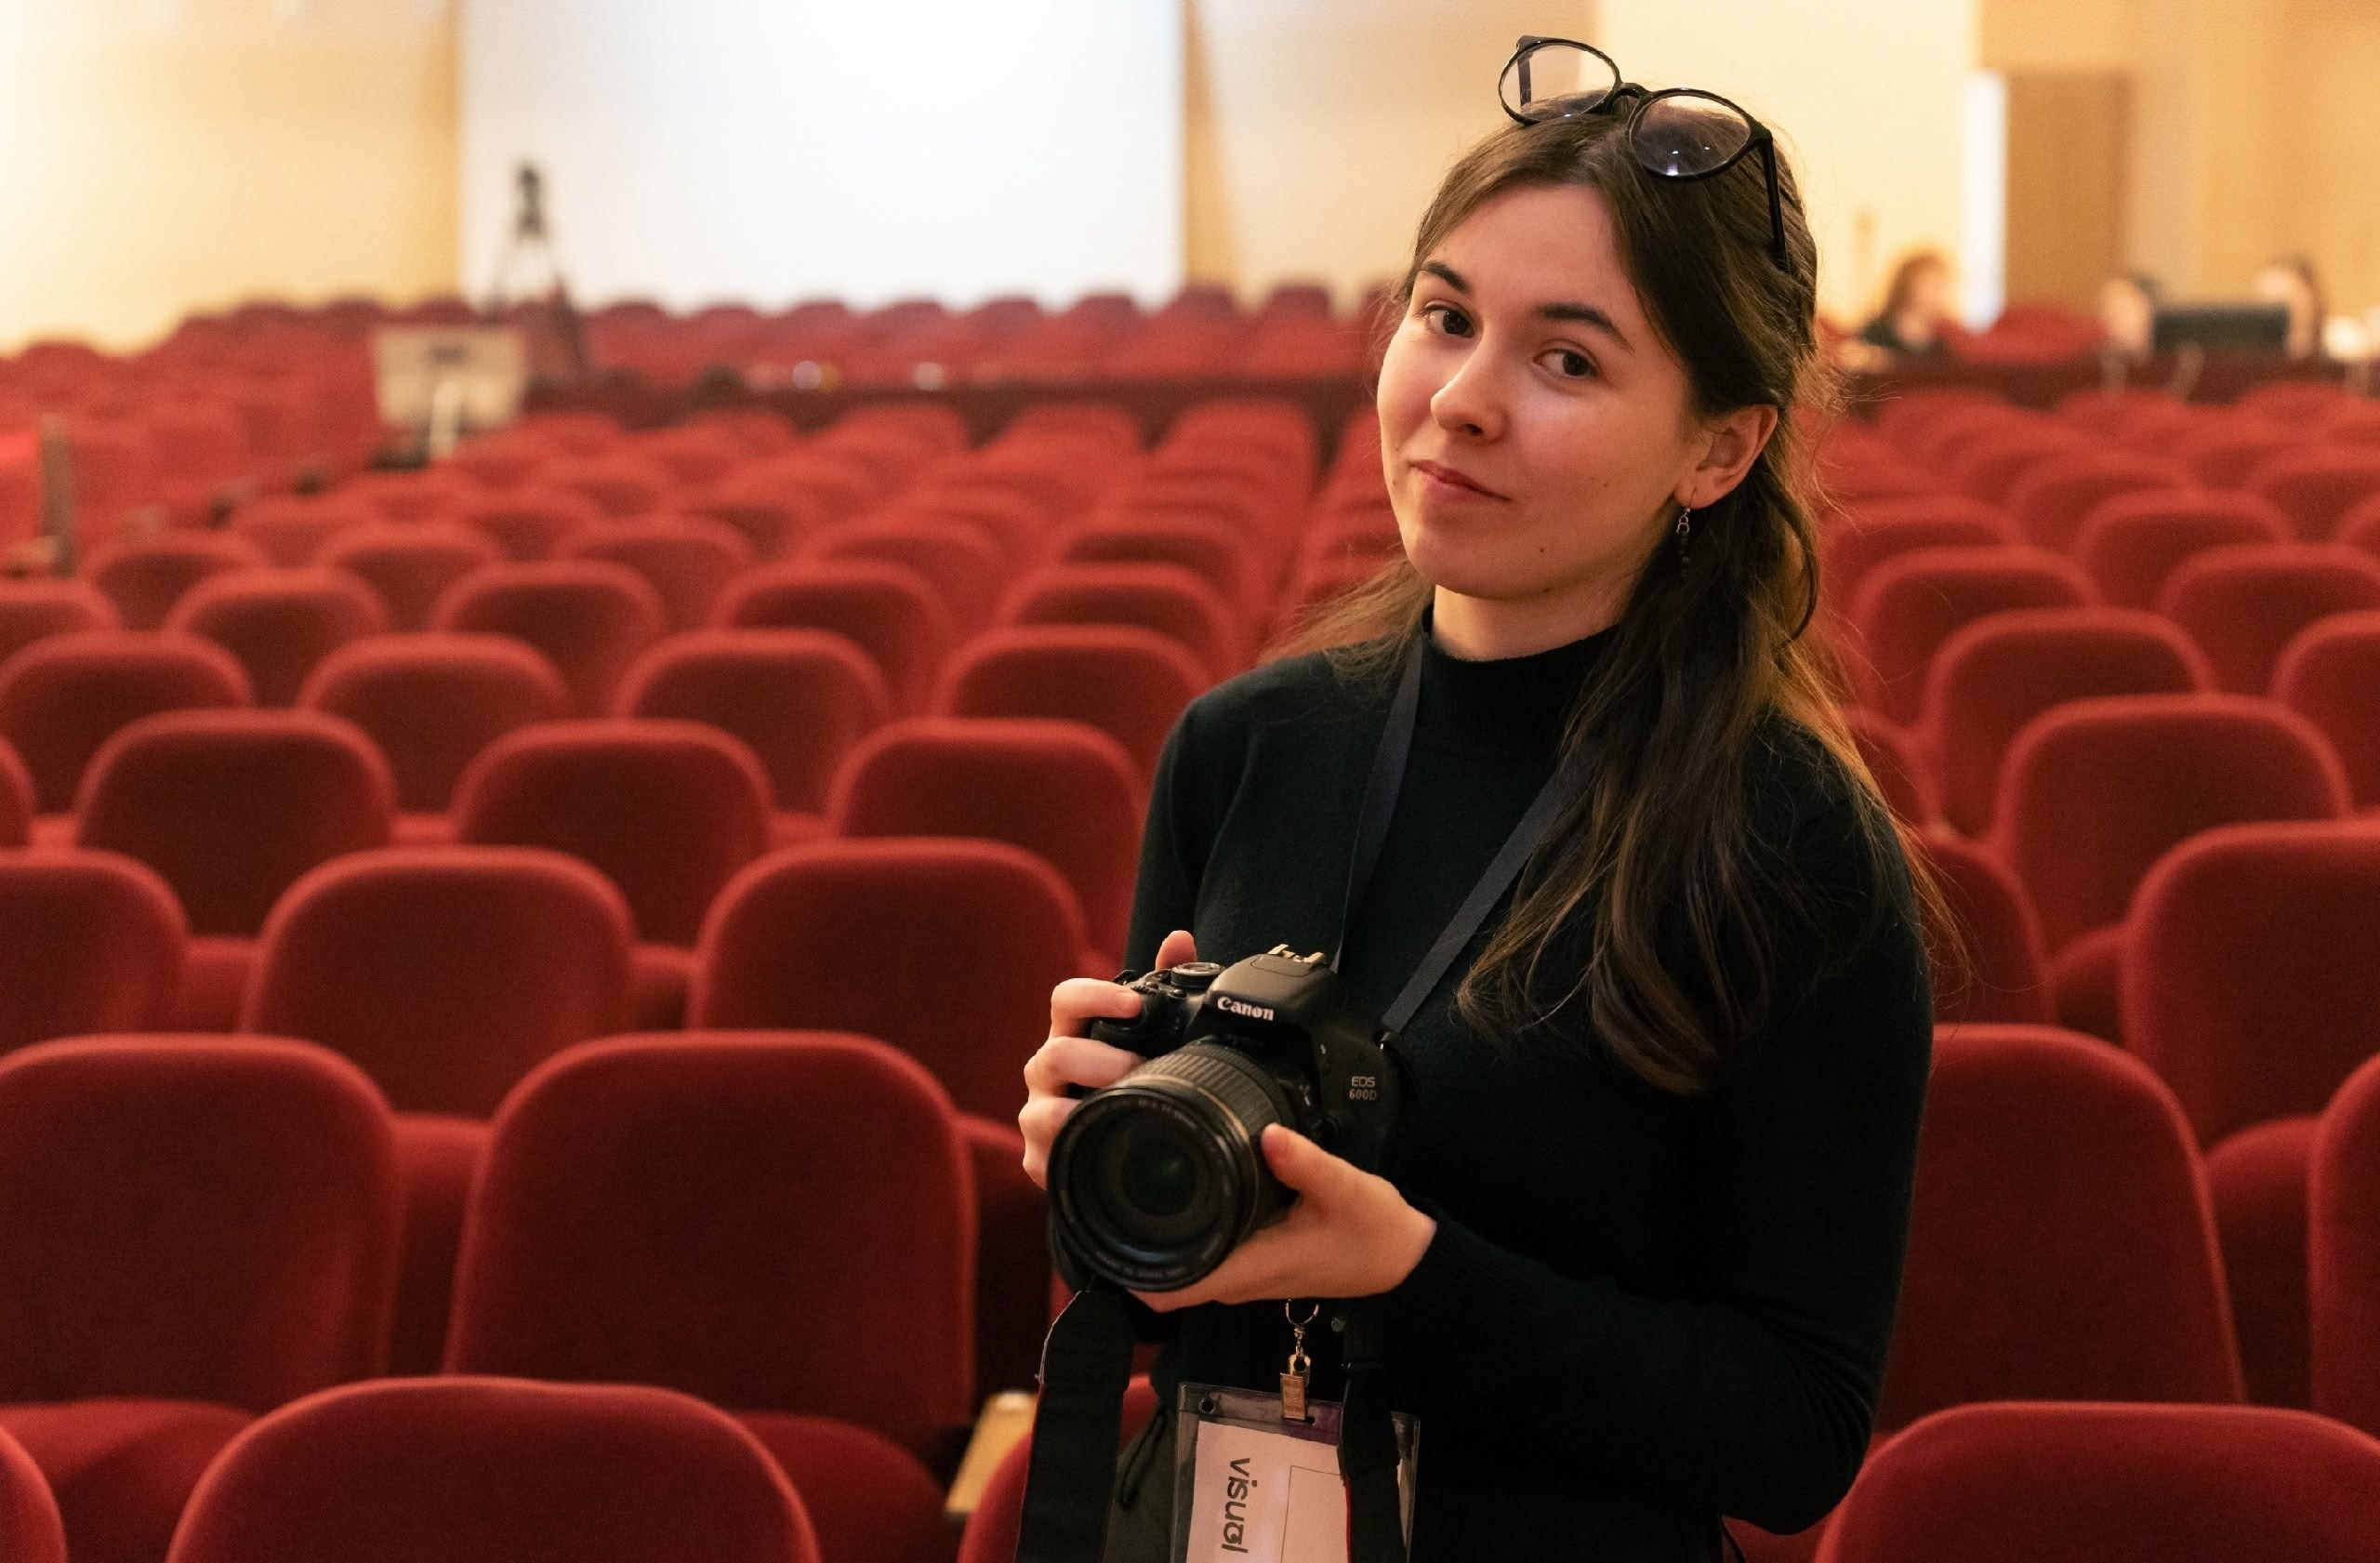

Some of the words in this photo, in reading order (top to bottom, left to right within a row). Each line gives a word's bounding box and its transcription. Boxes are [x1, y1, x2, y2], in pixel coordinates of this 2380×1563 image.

[1217, 996, 1274, 1021] Canon
[1351, 1076, 1376, 1088] EOS
[1349, 1088, 1377, 1101] 600D
[1221, 1457, 1258, 1554] visual
